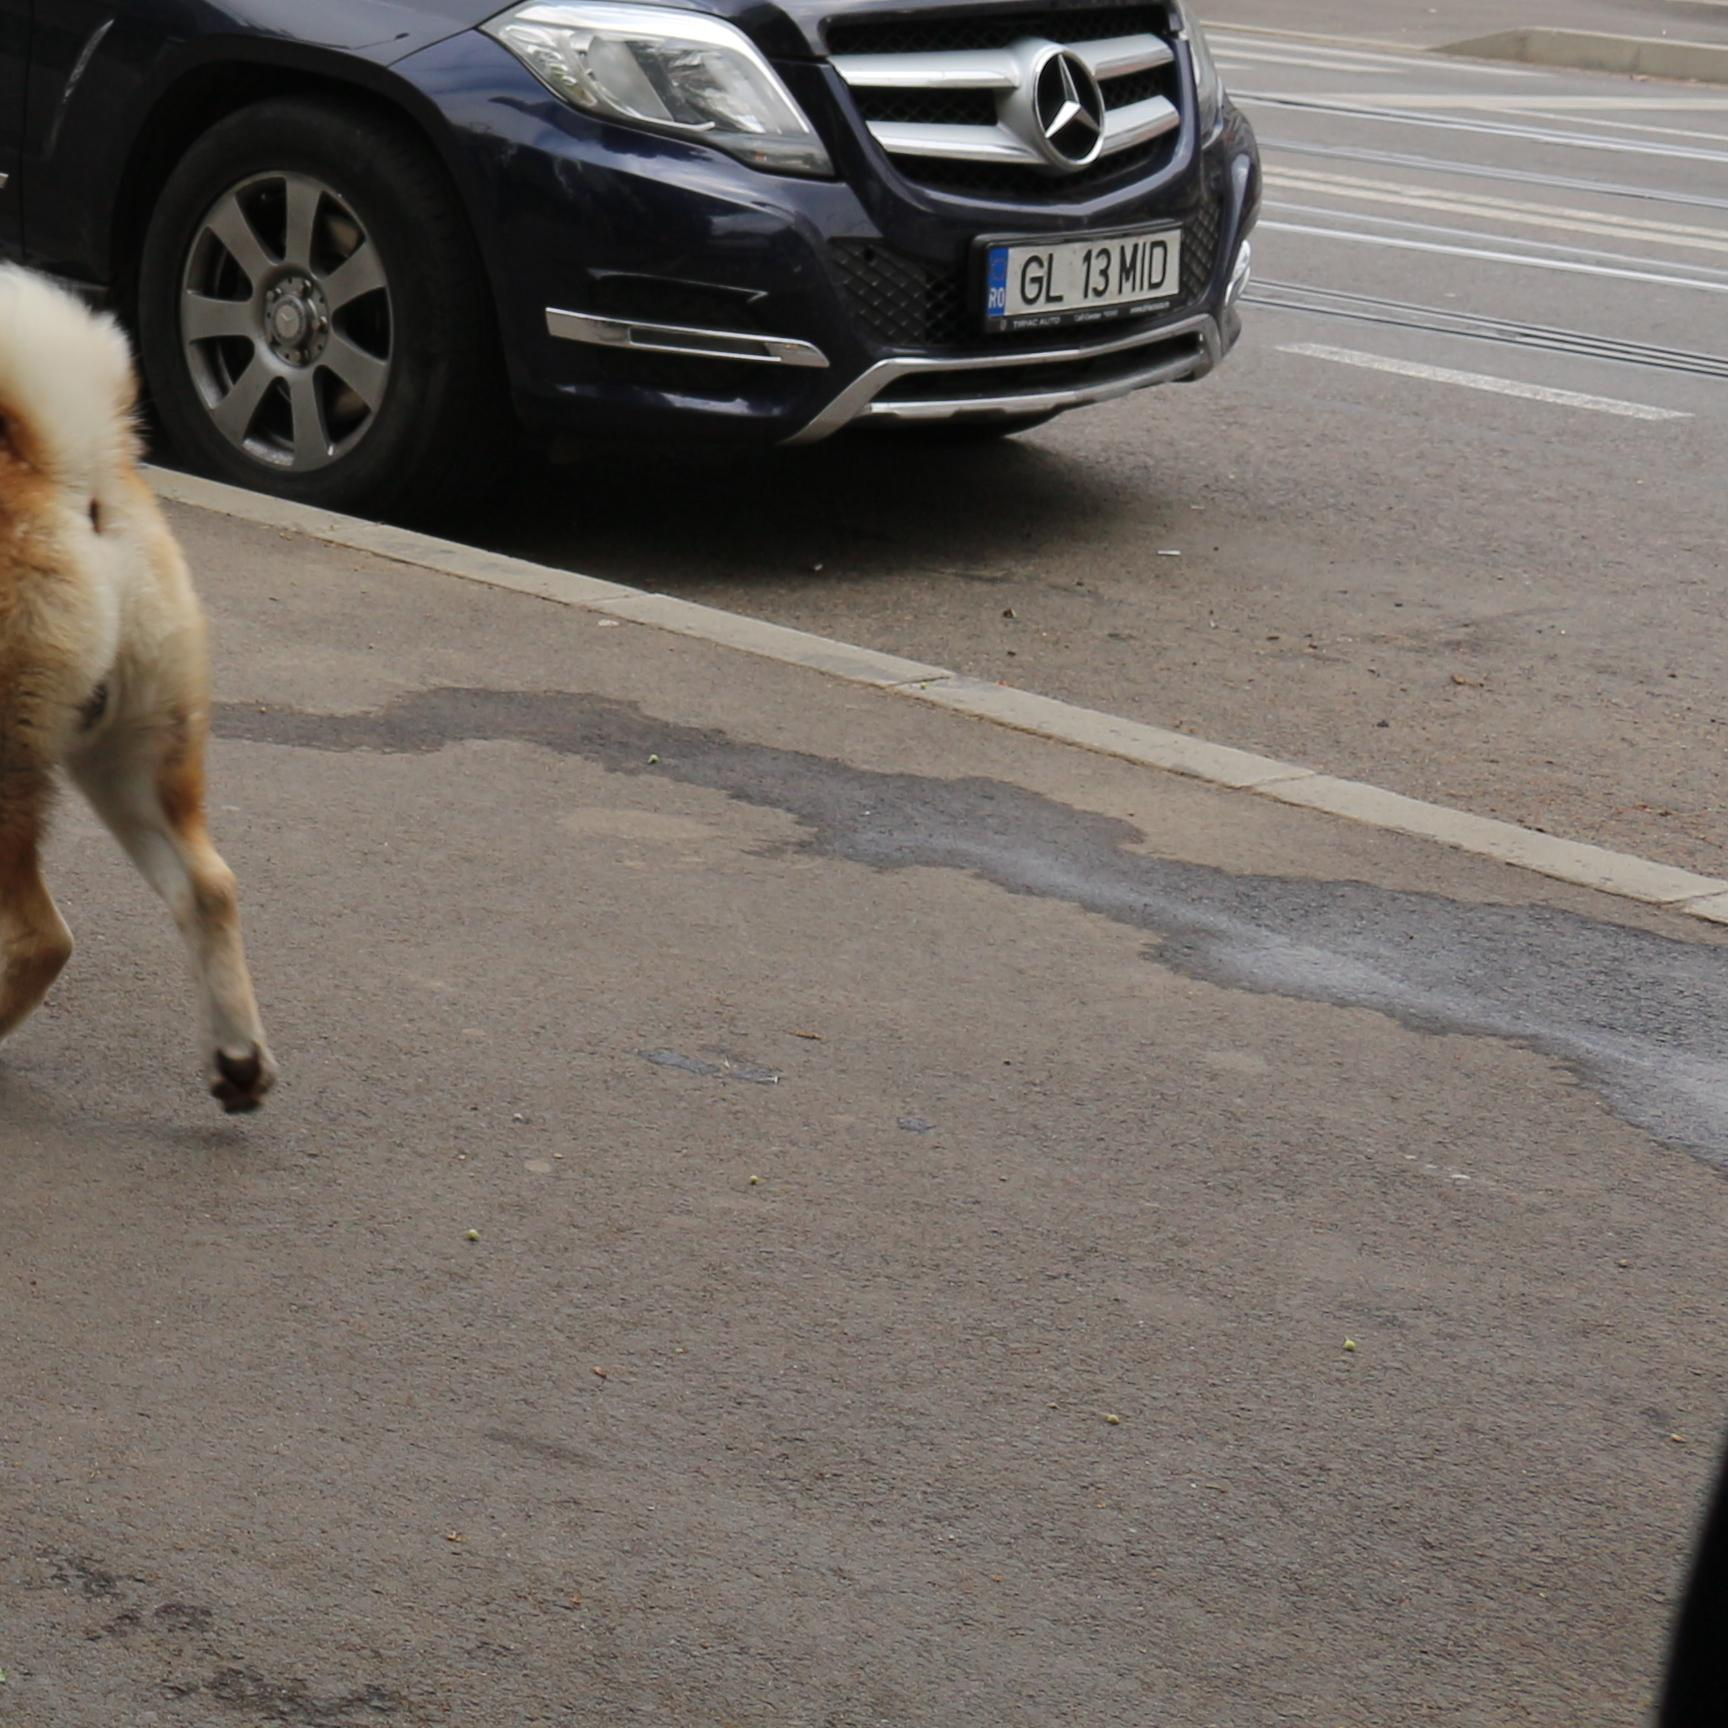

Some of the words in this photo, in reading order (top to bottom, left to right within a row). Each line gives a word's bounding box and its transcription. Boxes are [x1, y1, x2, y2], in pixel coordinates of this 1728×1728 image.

[1020, 253, 1063, 305] GL
[1082, 247, 1111, 299] 13
[1118, 239, 1167, 295] MID
[989, 287, 1004, 309] RO
